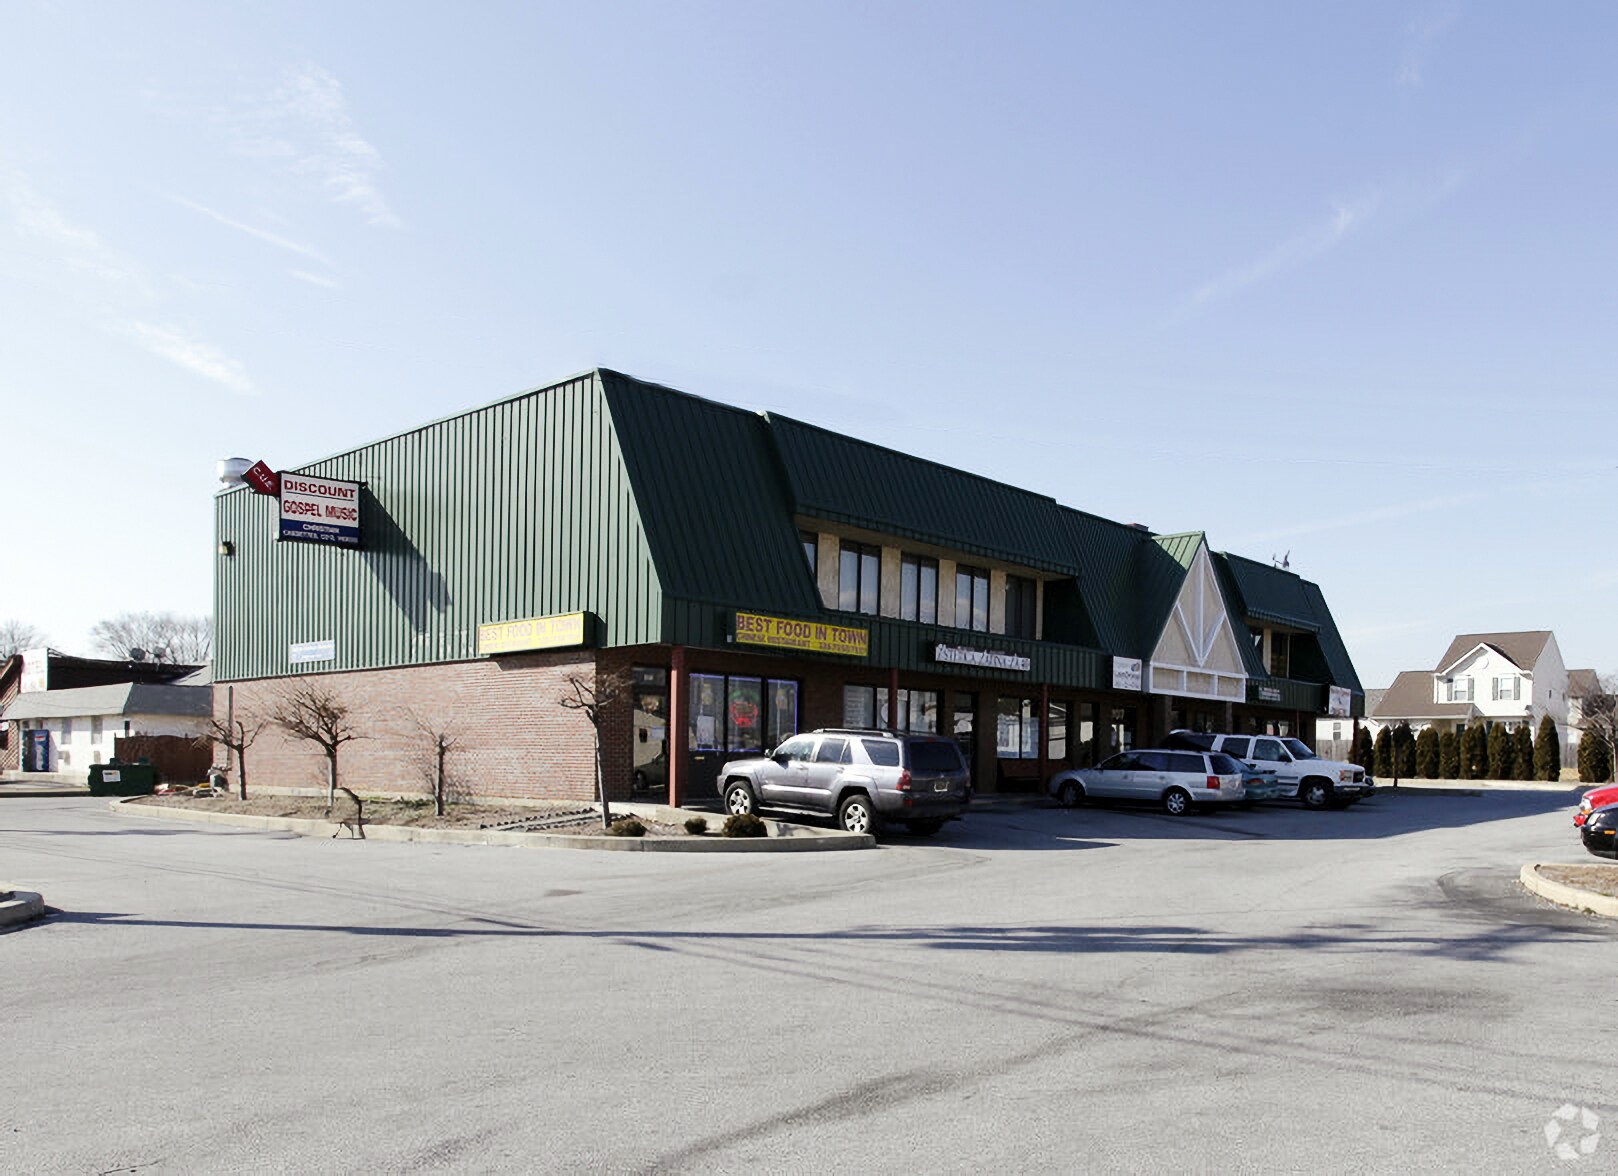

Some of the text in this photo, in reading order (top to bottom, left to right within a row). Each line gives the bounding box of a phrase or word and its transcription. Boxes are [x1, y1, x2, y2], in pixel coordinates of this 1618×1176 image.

[284, 480, 356, 498] DISCOUNT
[283, 499, 357, 521] GOSPEL MUSIC
[736, 614, 866, 645] BEST FOOD IN TOWN
